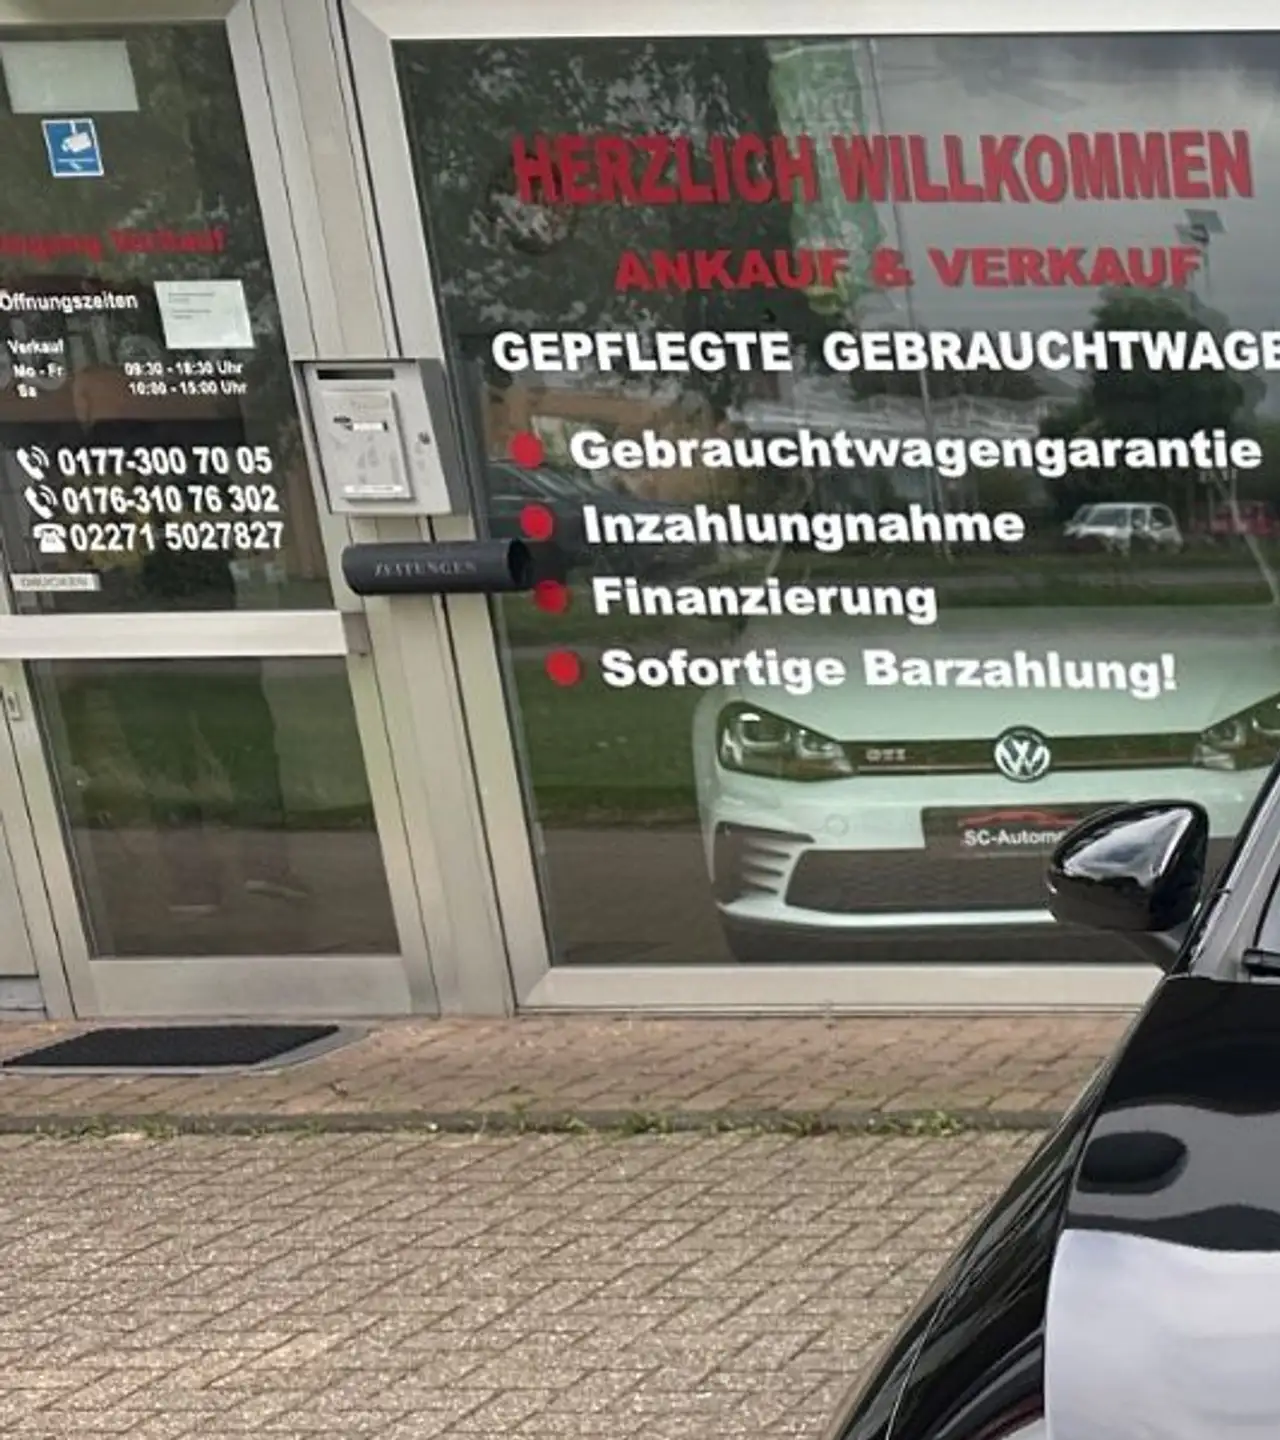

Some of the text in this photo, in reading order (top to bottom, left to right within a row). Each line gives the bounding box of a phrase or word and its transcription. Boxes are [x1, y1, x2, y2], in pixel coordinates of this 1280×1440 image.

[513, 131, 1253, 204] HERZLICH WILLKOMMEN
[616, 246, 1200, 290] ANKAUF & VERKAUF
[218, 360, 244, 375] Uhr
[492, 332, 793, 371] GEPFLEGTE
[222, 380, 248, 395] Uhr
[58, 446, 273, 476] 0177-300 70 05
[570, 430, 1263, 477] Gebrauchtwagengarantie
[62, 484, 281, 515] 0176-310 76 302
[70, 520, 284, 551] 02271 5027827
[583, 505, 1024, 550] Inzahlungnahme
[593, 577, 937, 625] Finanzierung
[602, 649, 1177, 699] Sofortige Barzahlung!
